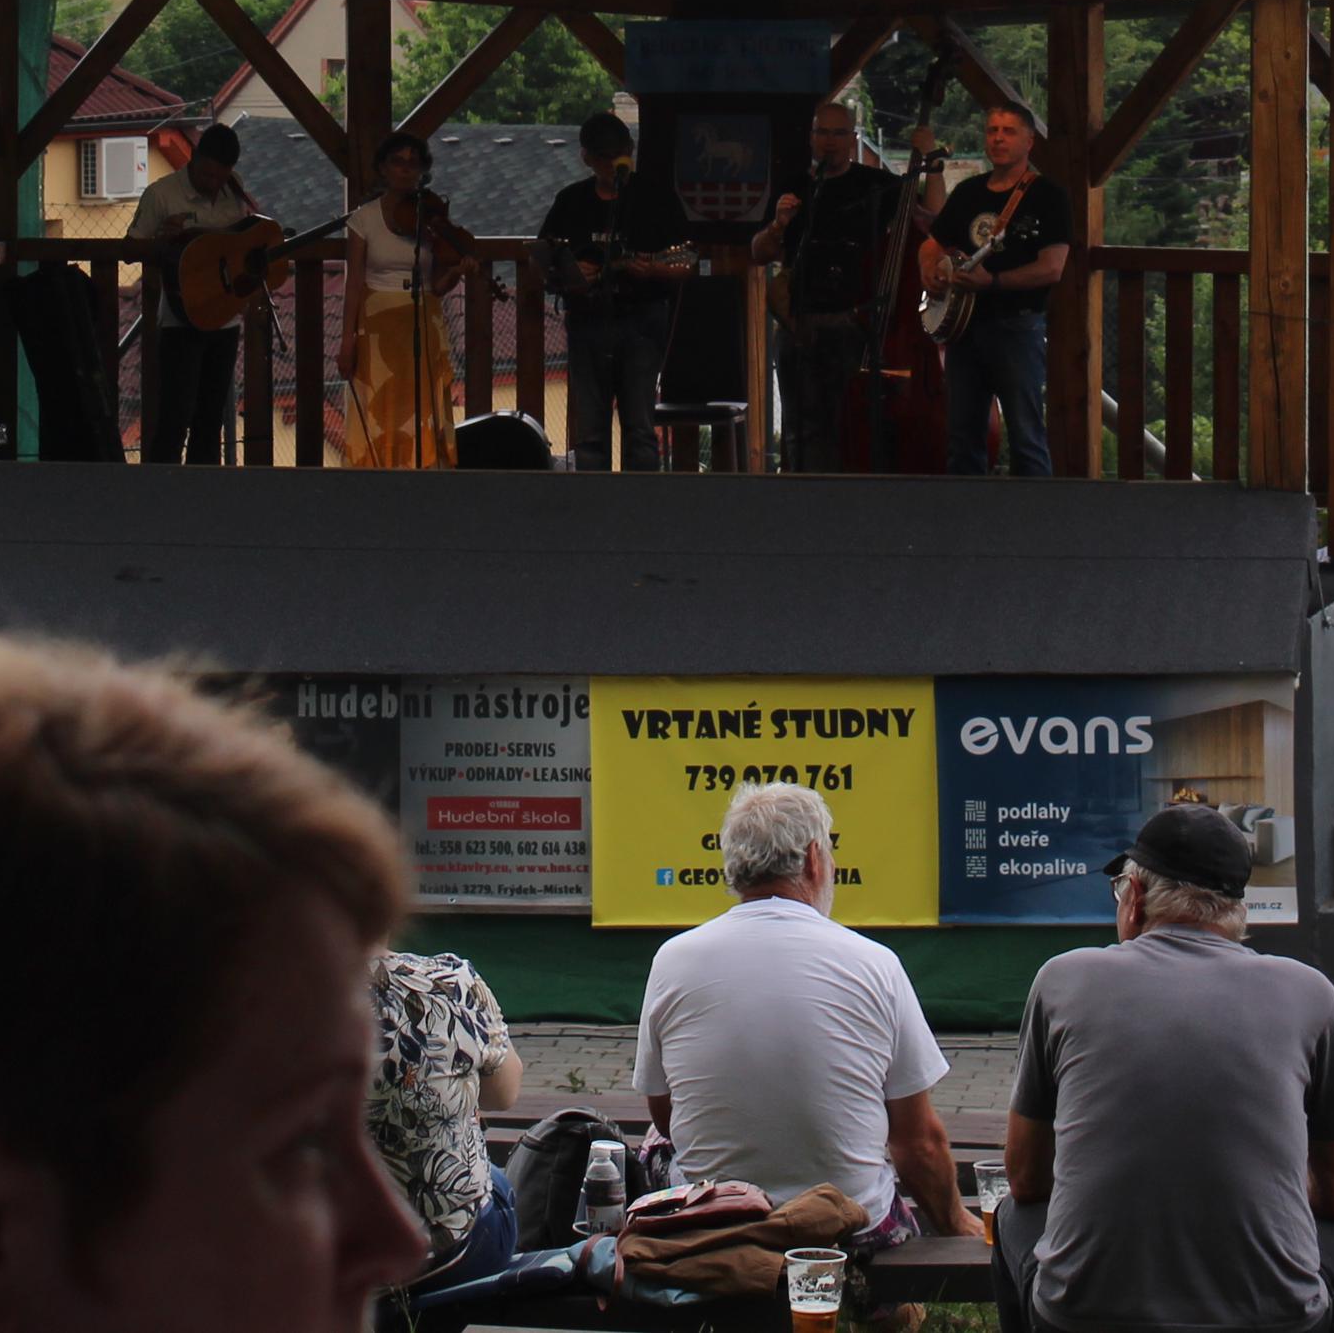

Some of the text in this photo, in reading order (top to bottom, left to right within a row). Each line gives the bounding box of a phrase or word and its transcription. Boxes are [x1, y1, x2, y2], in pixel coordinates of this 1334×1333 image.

[298, 683, 590, 727] Hudební nástroje
[621, 700, 915, 740] VRTANÉ STUDNY
[960, 715, 1154, 755] evans
[685, 764, 736, 791] 739
[805, 763, 853, 790] 761
[438, 810, 571, 824] Hudební škola
[997, 802, 1071, 823] podlahy
[466, 840, 487, 856] 623
[517, 841, 538, 856] 602
[541, 841, 561, 856] 614
[564, 841, 587, 856] 438
[997, 830, 1050, 848] dveře
[998, 858, 1088, 878] ekopaliva
